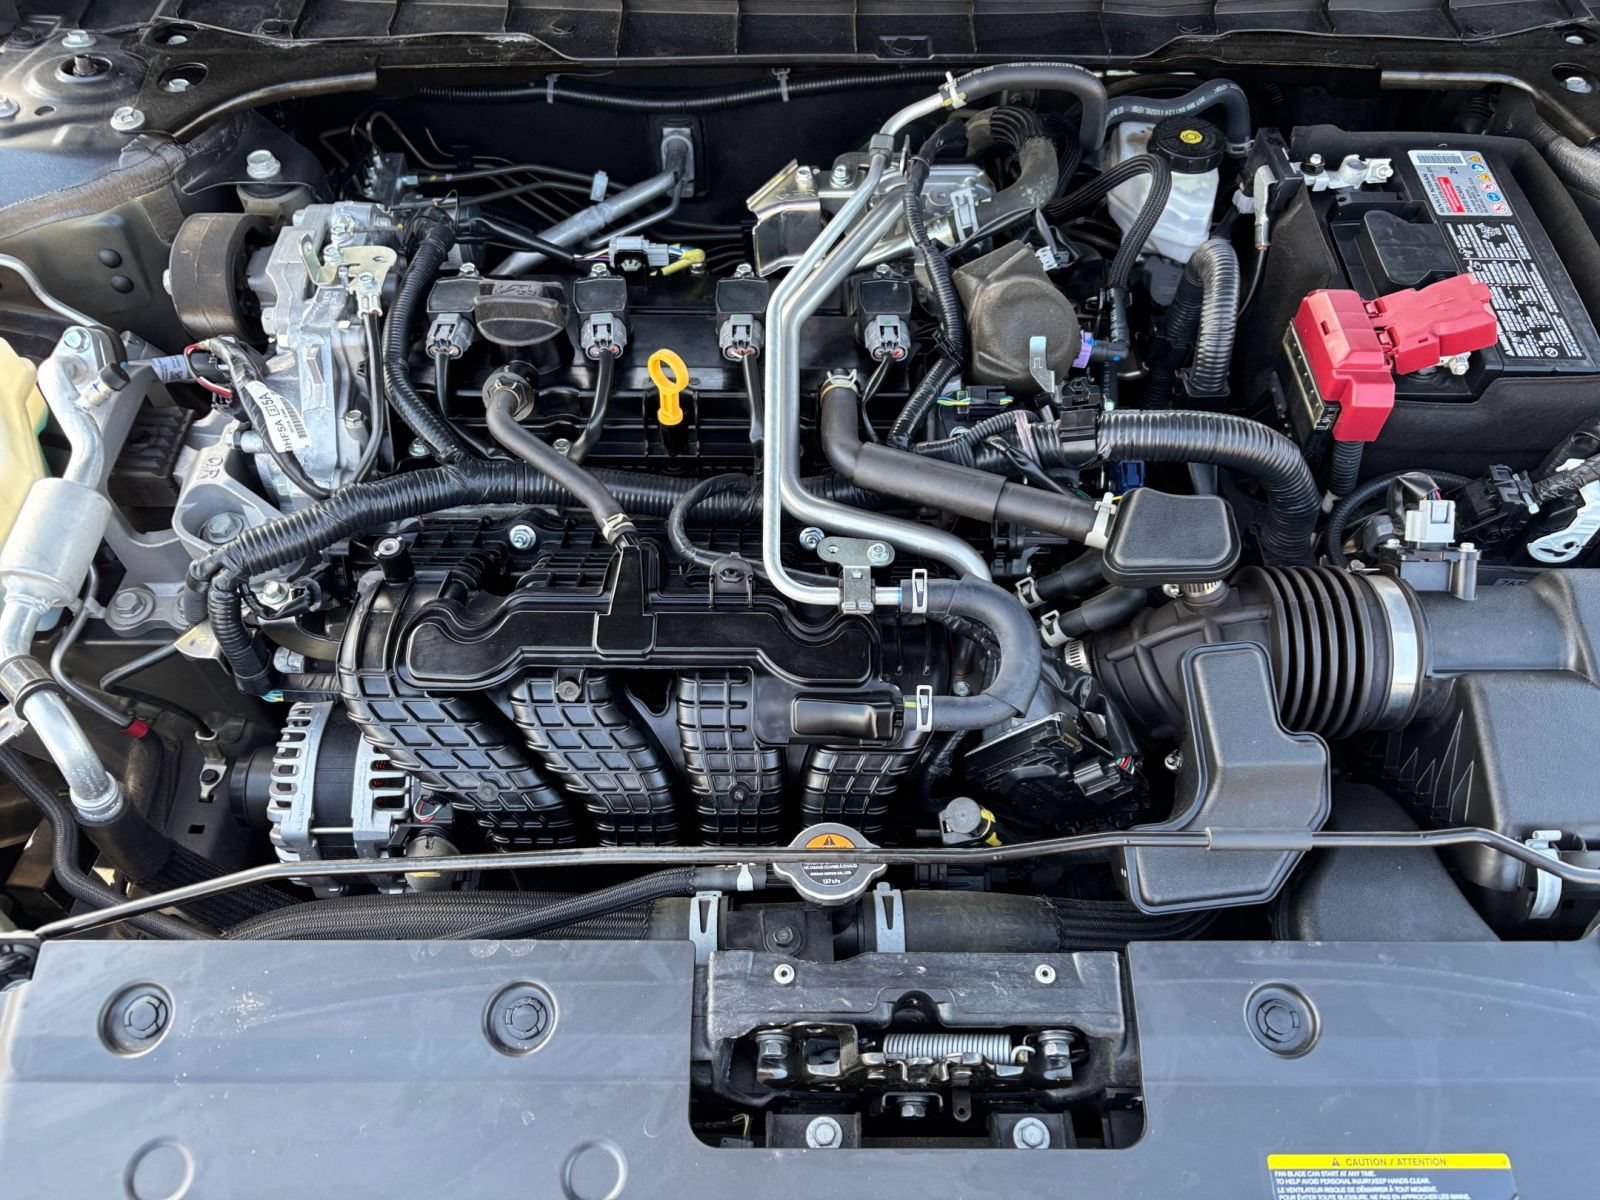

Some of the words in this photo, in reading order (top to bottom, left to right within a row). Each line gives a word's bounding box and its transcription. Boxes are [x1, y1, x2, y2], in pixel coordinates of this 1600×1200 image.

[1446, 166, 1459, 174] 26
[1421, 173, 1435, 192] NISSAN
[1346, 1158, 1386, 1166] CAUTION
[1398, 1158, 1446, 1166] ATTENTION
